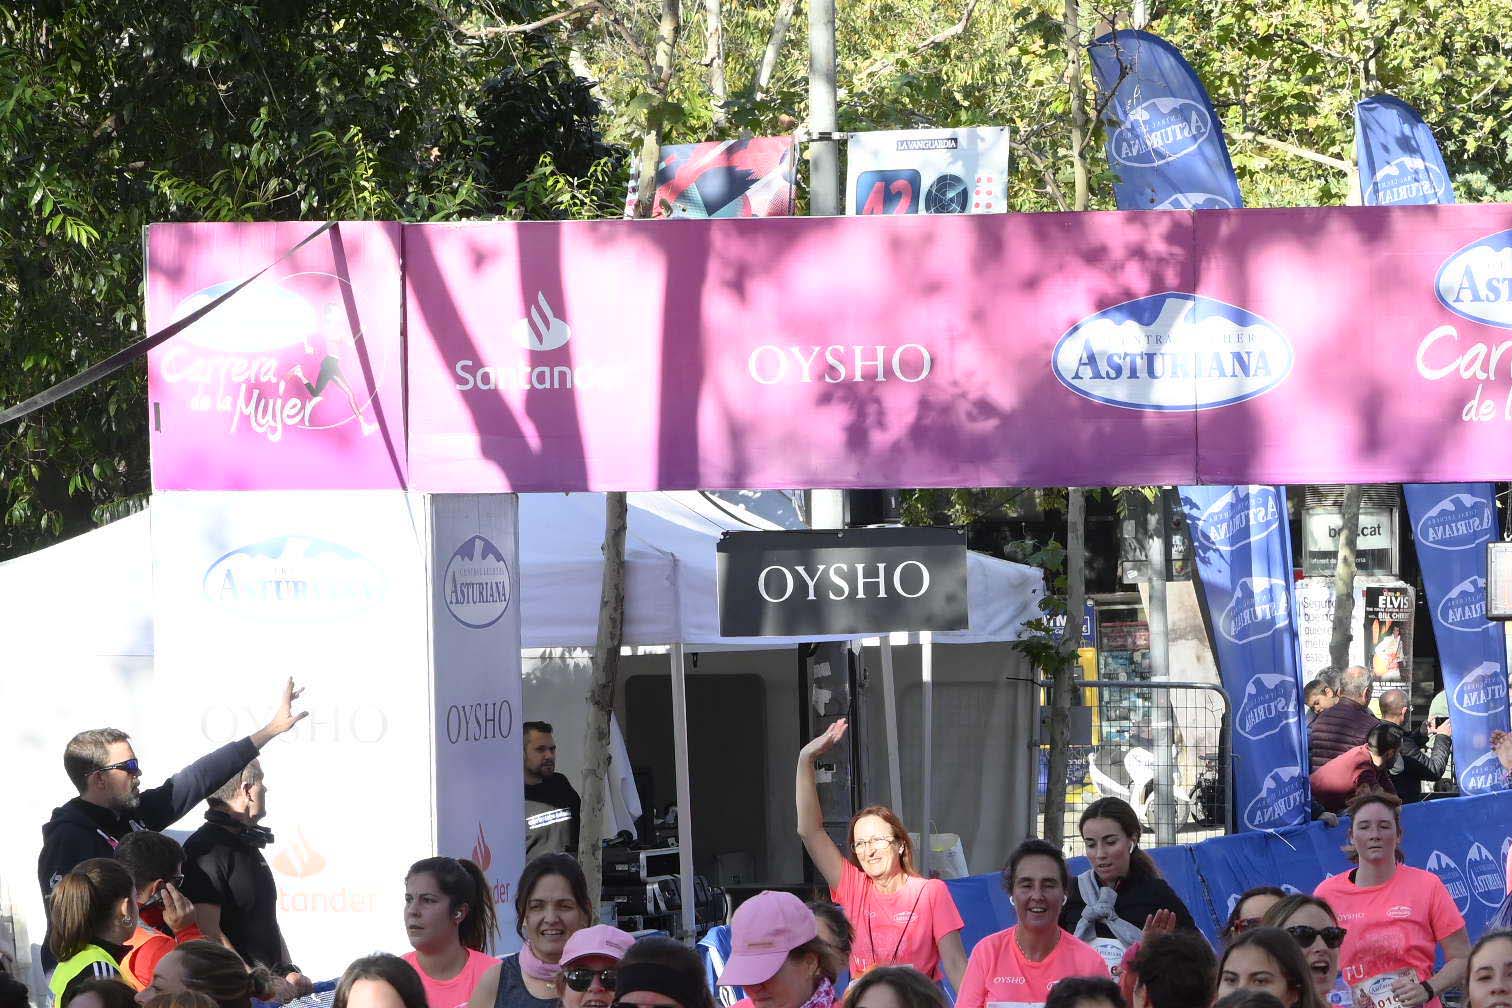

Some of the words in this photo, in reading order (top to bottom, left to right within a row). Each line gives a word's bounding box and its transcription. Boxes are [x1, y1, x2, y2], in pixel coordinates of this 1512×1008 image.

[909, 138, 957, 151] VANGUARDIA
[161, 349, 278, 386] Carrera
[747, 343, 933, 386] OYSHO
[230, 378, 324, 443] Mujer
[1461, 383, 1497, 422] de
[448, 570, 508, 606] ASTURIANA
[757, 559, 931, 604] OYSHO
[1378, 595, 1410, 609] ELVIS
[200, 704, 389, 745] OYHO
[446, 698, 514, 745] OYSHO
[277, 880, 378, 914] tander
[993, 976, 1026, 985] OYSHO
[1344, 963, 1364, 981] TU
